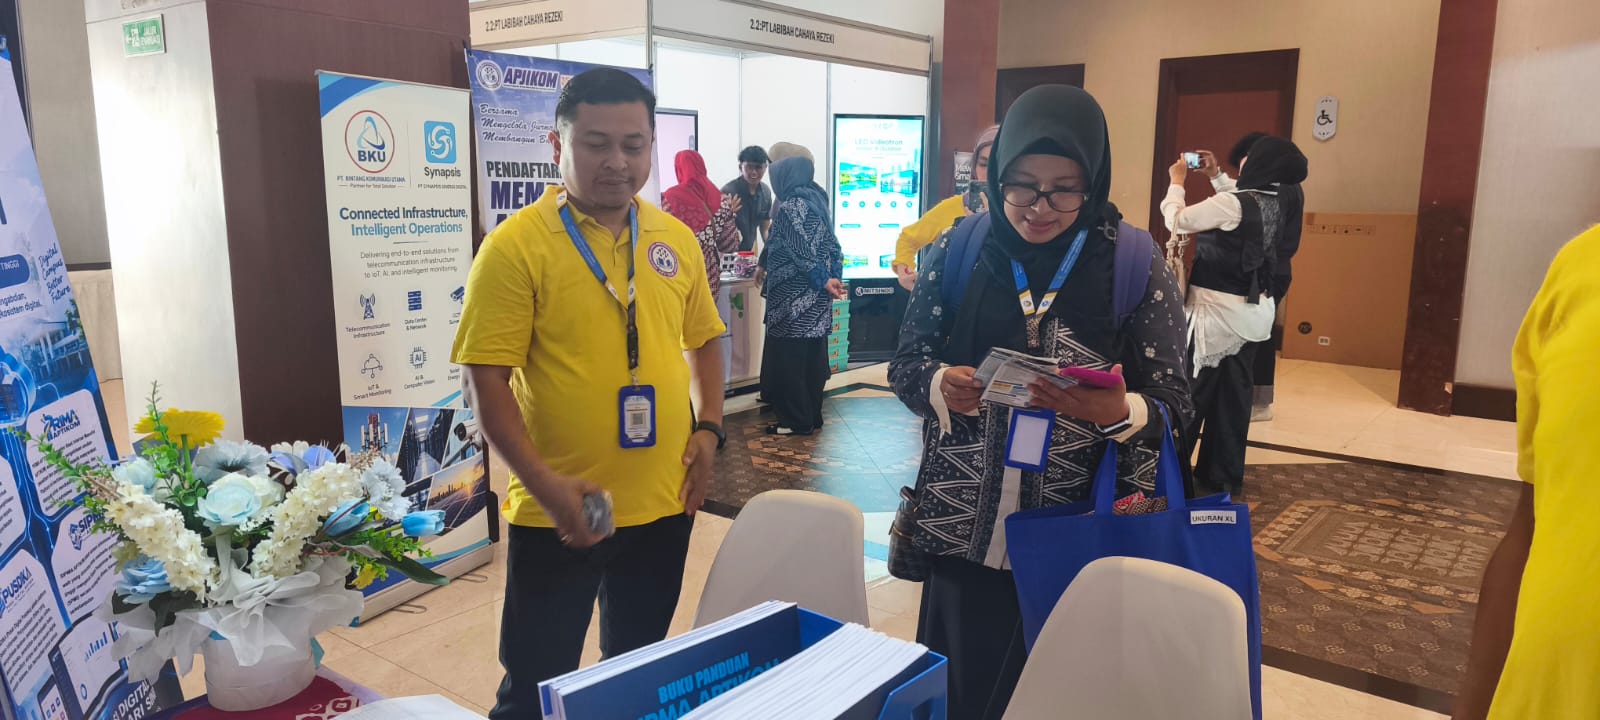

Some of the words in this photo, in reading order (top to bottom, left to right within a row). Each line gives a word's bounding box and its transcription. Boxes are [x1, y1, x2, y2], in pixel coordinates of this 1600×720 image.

[501, 17, 524, 30] LABIBAH
[524, 14, 544, 26] CAHAYA
[544, 10, 564, 23] REZEKI
[770, 22, 794, 37] LABIBAH
[795, 26, 816, 41] CAHAYA
[816, 30, 835, 44] REZEKI
[504, 68, 558, 89] APJIKOM
[480, 104, 518, 116] Bersama
[482, 118, 527, 131] Mengelola
[482, 132, 536, 144] Membangun
[357, 150, 386, 162] BKU
[424, 166, 462, 180] Synapsis
[486, 161, 562, 178] PENDAFTAR
[490, 181, 565, 210] MEM
[339, 206, 400, 220] Connected
[402, 206, 468, 220] Infrastructure,
[352, 224, 406, 238] Intelligent
[409, 222, 463, 236] Operations
[39, 242, 58, 268] Digital
[360, 250, 390, 258] Delivering
[42, 258, 64, 280] Campus
[367, 259, 419, 268] telecommunication
[403, 267, 428, 275] intelligent
[46, 275, 63, 294] Better
[50, 285, 71, 304] Future
[0, 305, 24, 318] kosistem
[346, 323, 390, 333] Telecommunication
[353, 331, 385, 339] Infrastructure
[369, 389, 392, 397] Monitoring
[53, 420, 80, 438] APTIKOM
[658, 675, 694, 704] BUKU
[695, 652, 750, 689] PANDUAN
[118, 678, 150, 718] DIGITAL
